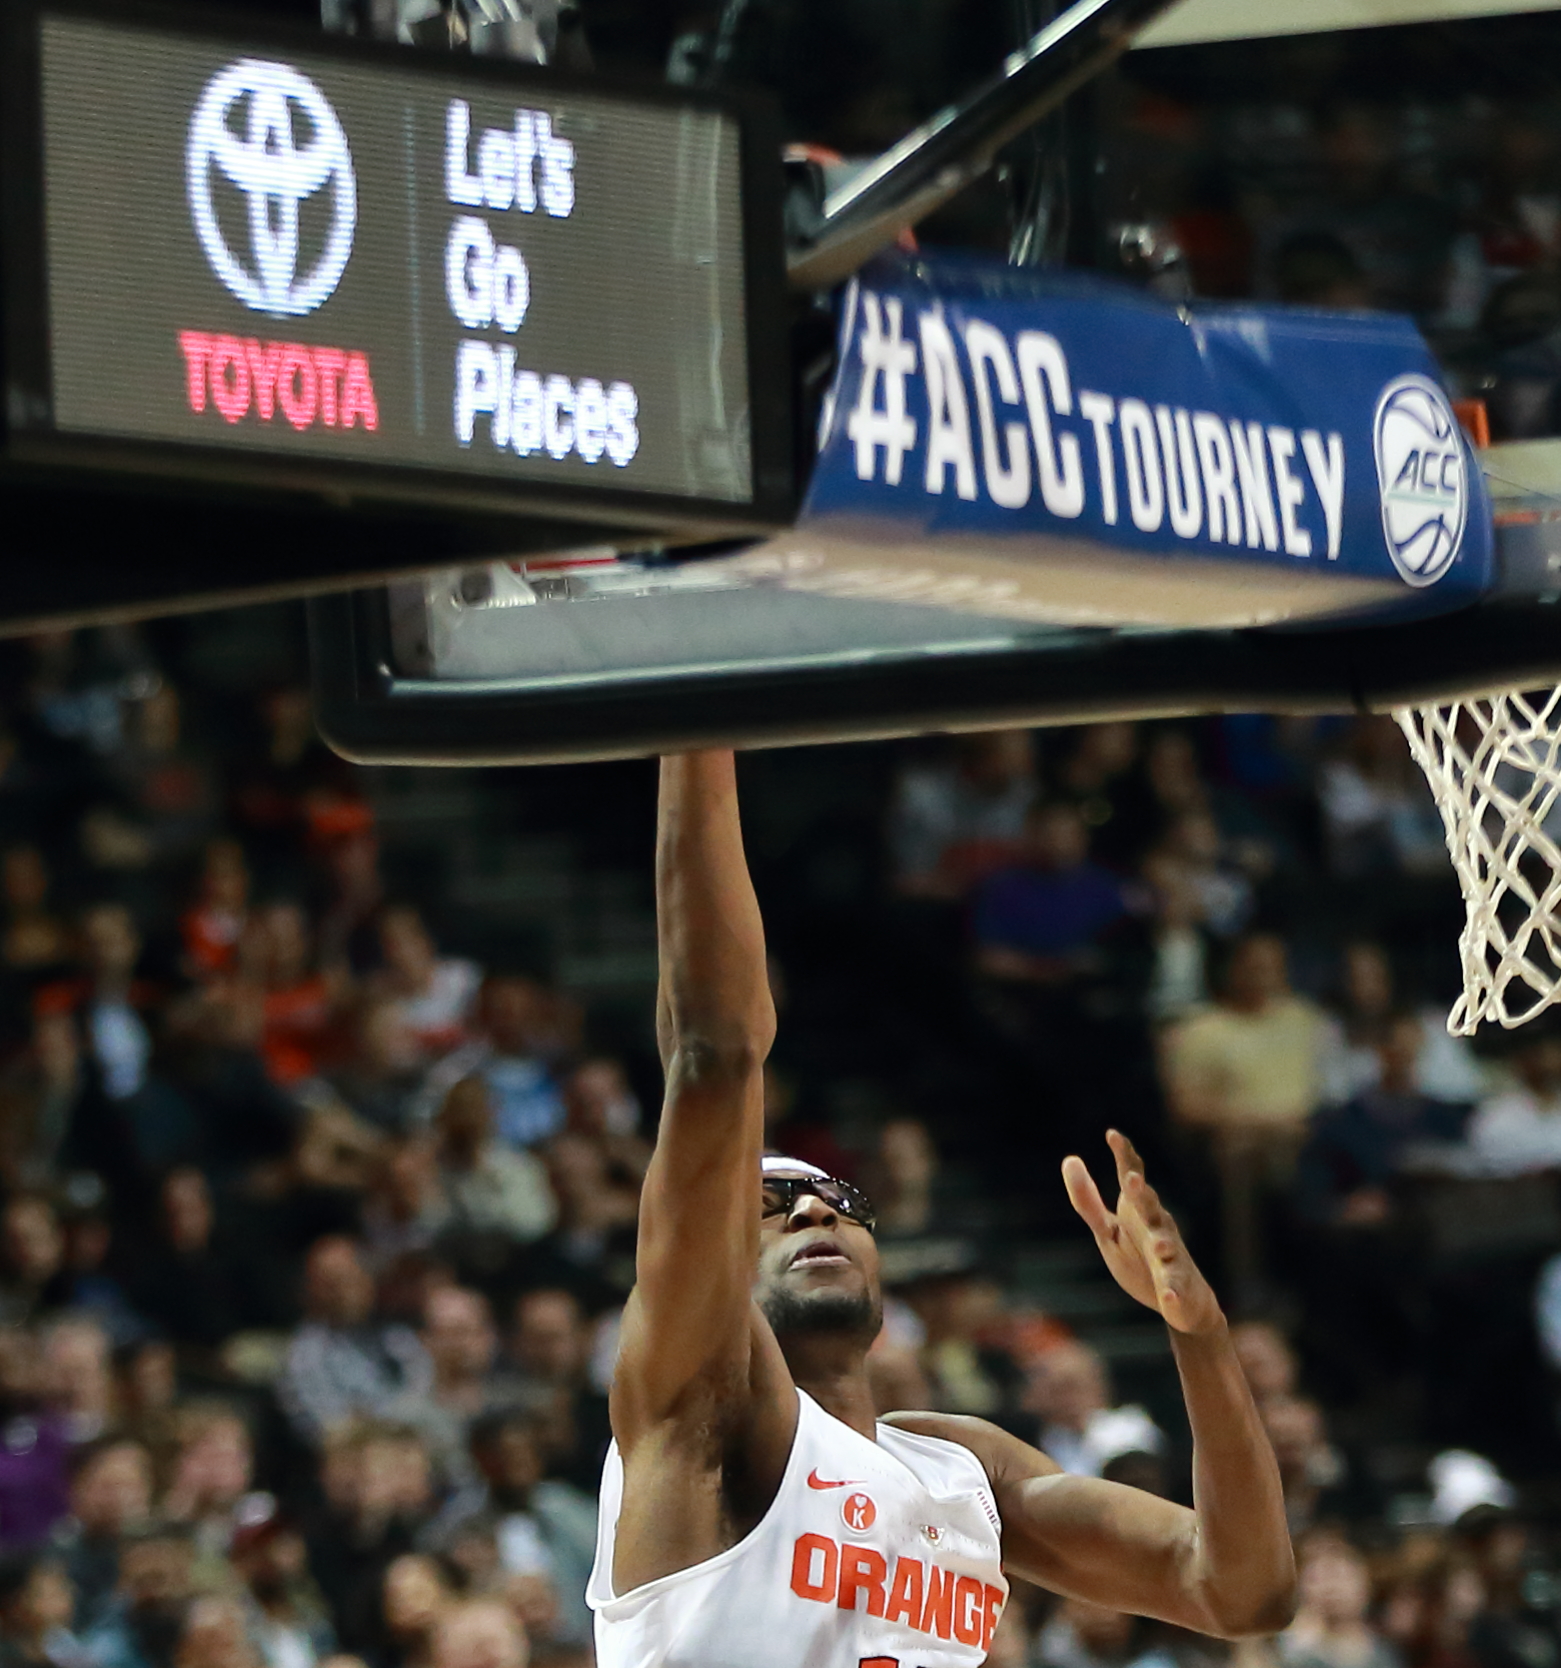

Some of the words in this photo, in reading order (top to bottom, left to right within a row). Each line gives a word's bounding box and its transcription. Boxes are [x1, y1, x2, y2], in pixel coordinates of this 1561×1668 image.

[445, 99, 576, 218] Let's
[445, 215, 530, 333] Go
[179, 330, 379, 431] TOYOTA
[454, 339, 639, 467] Places
[1394, 449, 1457, 491] ACC
[790, 1532, 1004, 1652] ORANGE
